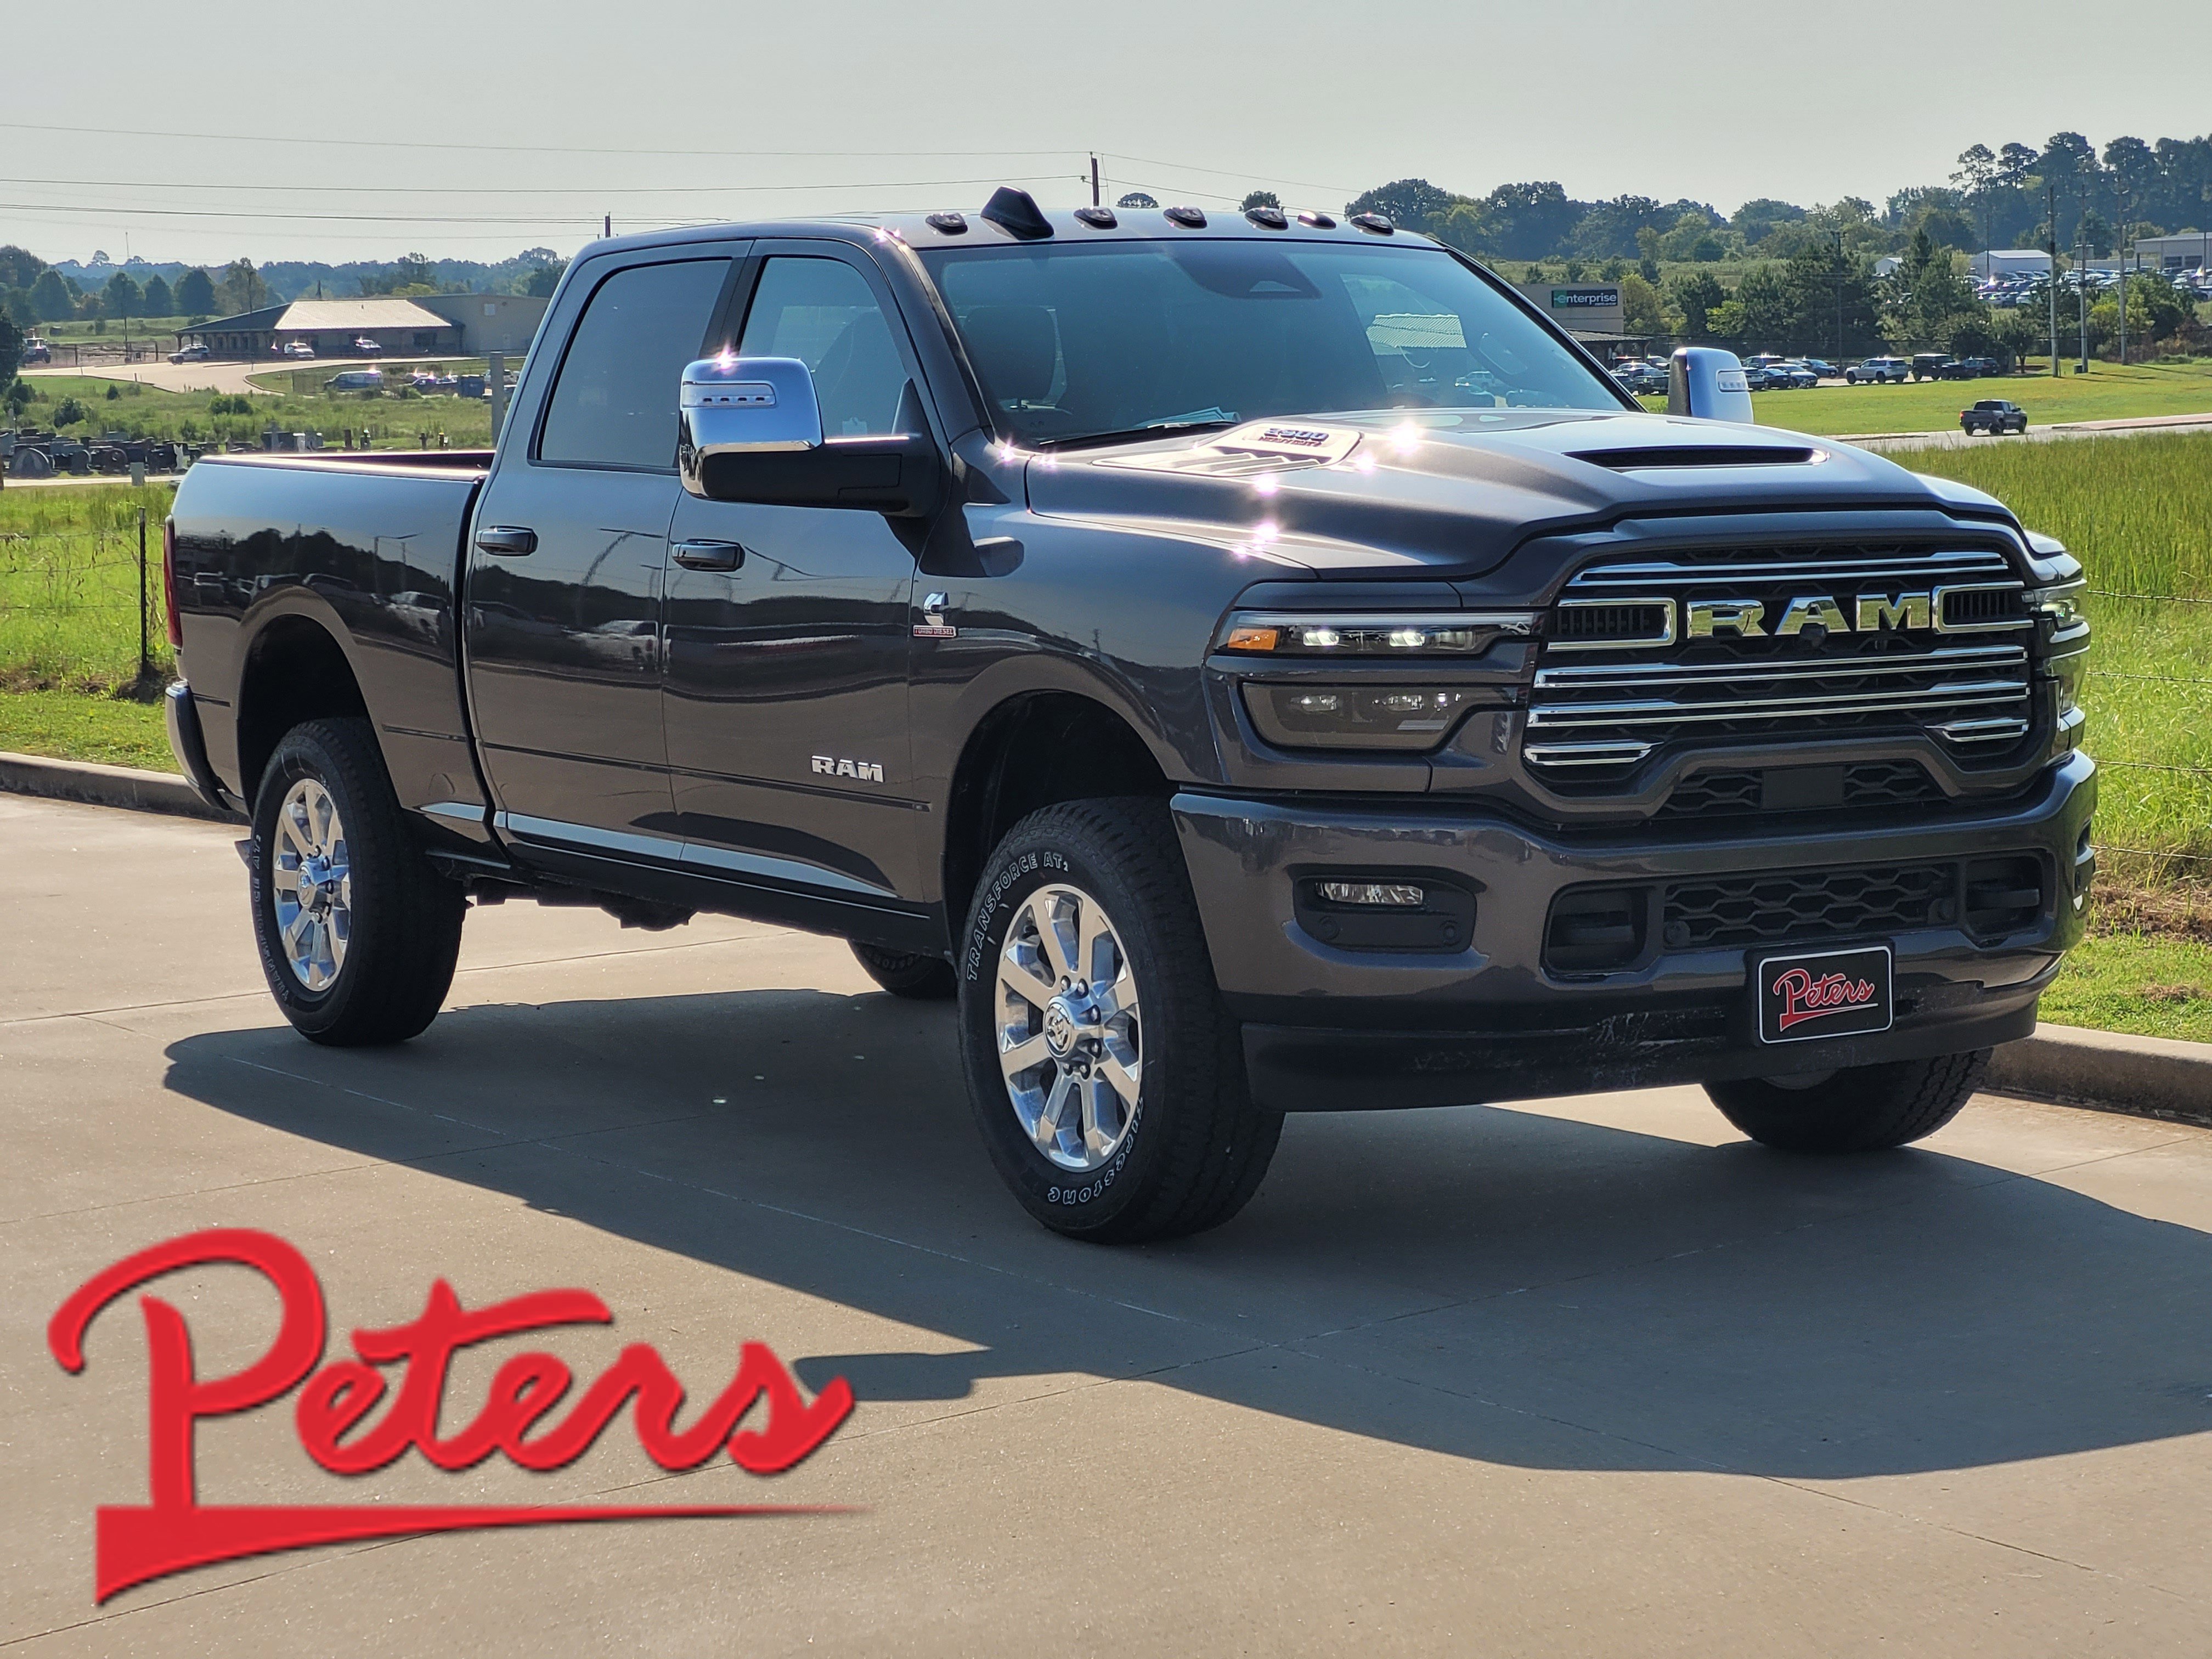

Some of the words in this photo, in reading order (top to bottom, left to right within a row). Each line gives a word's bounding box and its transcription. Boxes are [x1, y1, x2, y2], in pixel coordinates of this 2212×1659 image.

[1554, 292, 1617, 305] enterprise
[1687, 592, 1930, 639] RAM
[811, 755, 884, 783] RAM
[967, 853, 1038, 981] TRANSFORCE
[1773, 968, 1875, 1018] Peters
